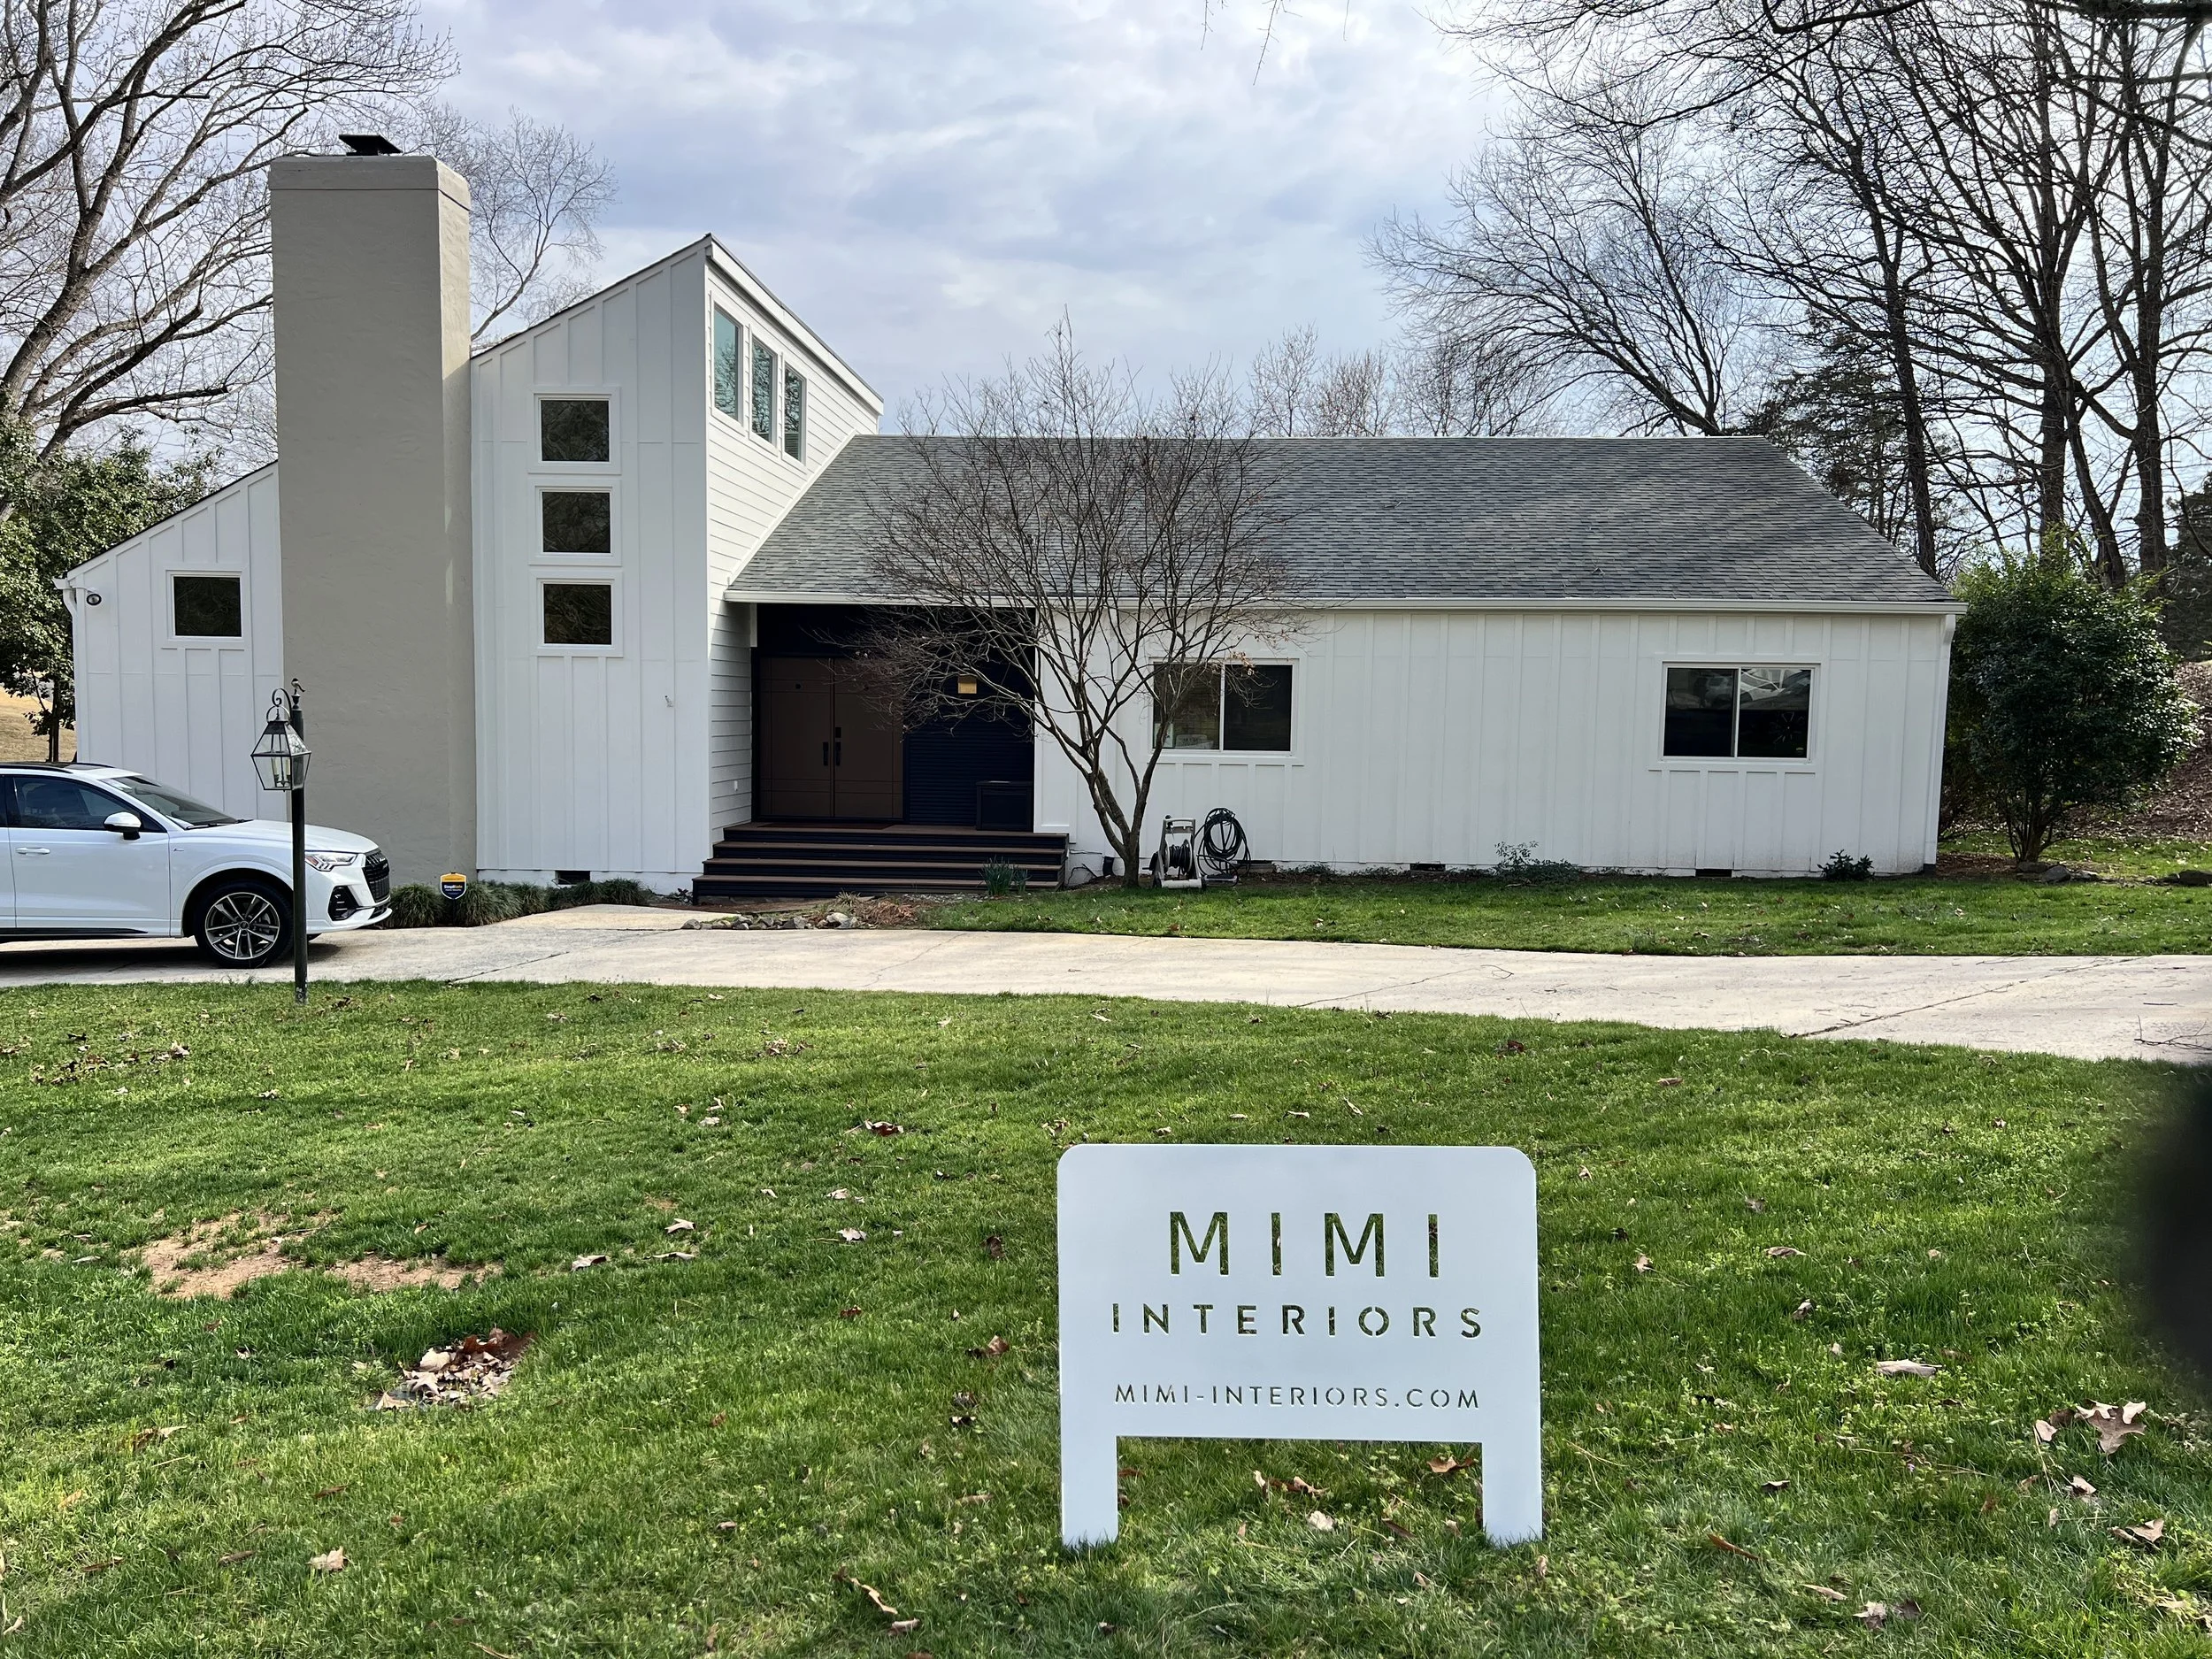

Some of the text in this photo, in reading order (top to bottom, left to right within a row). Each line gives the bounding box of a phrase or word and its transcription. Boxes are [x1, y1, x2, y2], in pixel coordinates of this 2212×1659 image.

[1170, 1211, 1440, 1279] MIMI
[1112, 1302, 1481, 1339] INTERIORS
[1114, 1384, 1479, 1409] MIMI-INTERIORS.COM
